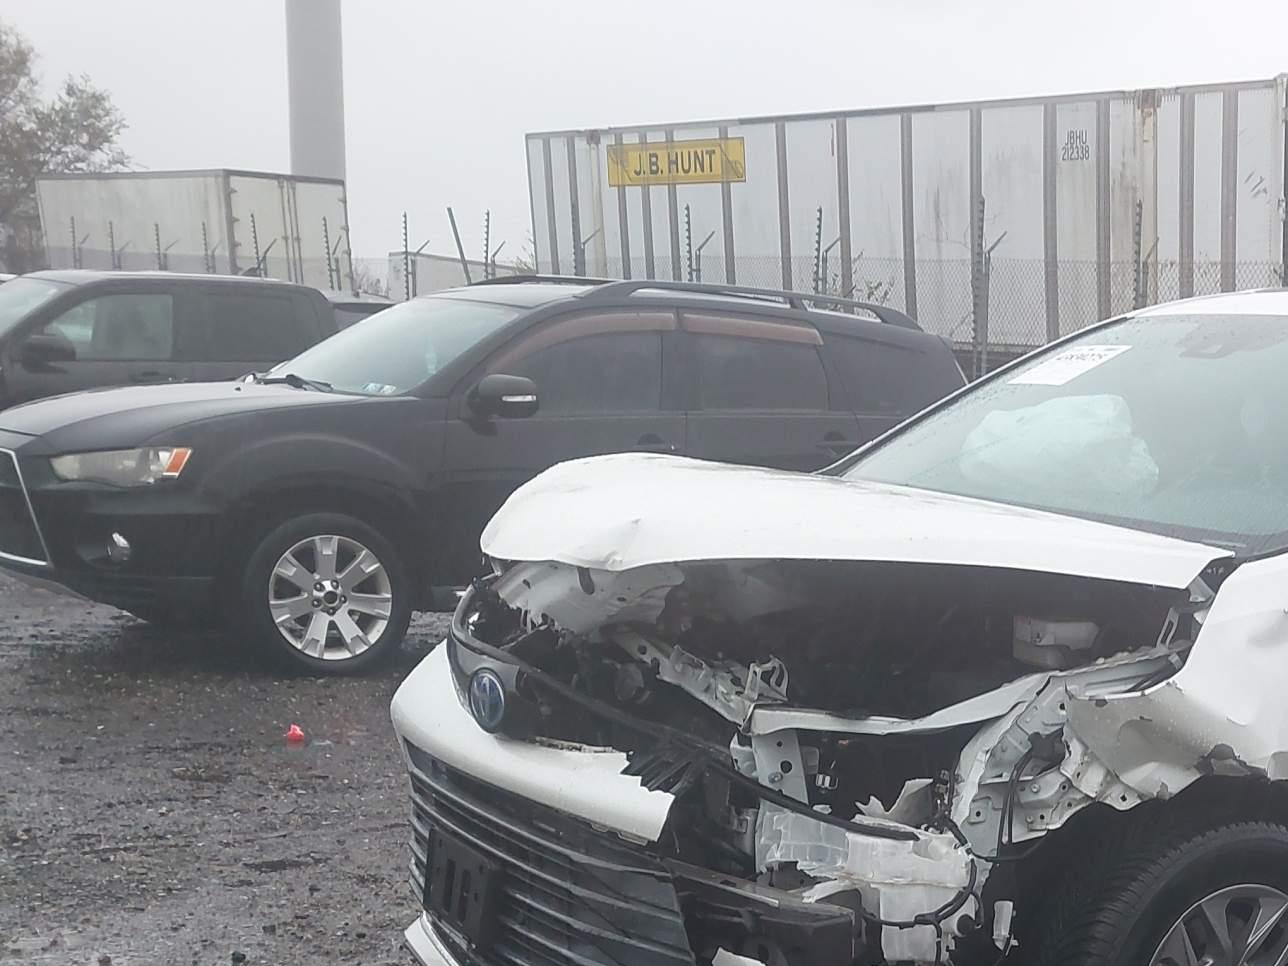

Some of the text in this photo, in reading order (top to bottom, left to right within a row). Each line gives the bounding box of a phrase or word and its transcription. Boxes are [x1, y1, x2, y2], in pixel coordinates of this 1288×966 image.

[1065, 129, 1088, 145] JBHU
[633, 148, 716, 177] J.B. HUNT
